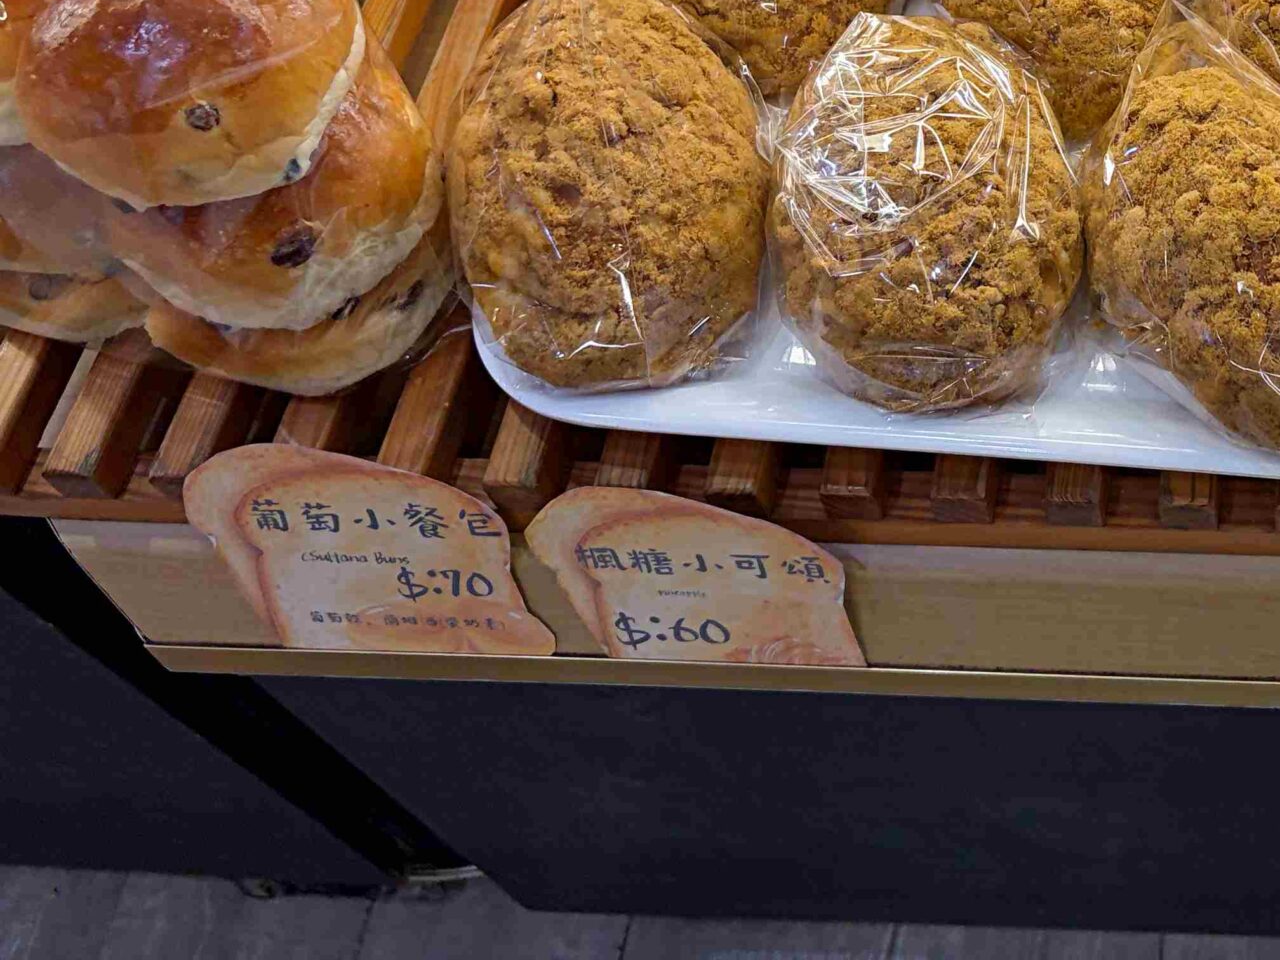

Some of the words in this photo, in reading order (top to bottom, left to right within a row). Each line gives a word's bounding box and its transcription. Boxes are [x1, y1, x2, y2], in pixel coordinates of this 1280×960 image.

[250, 499, 503, 540] 葡萄小餐包
[575, 544, 832, 584] 楓糖小可頌
